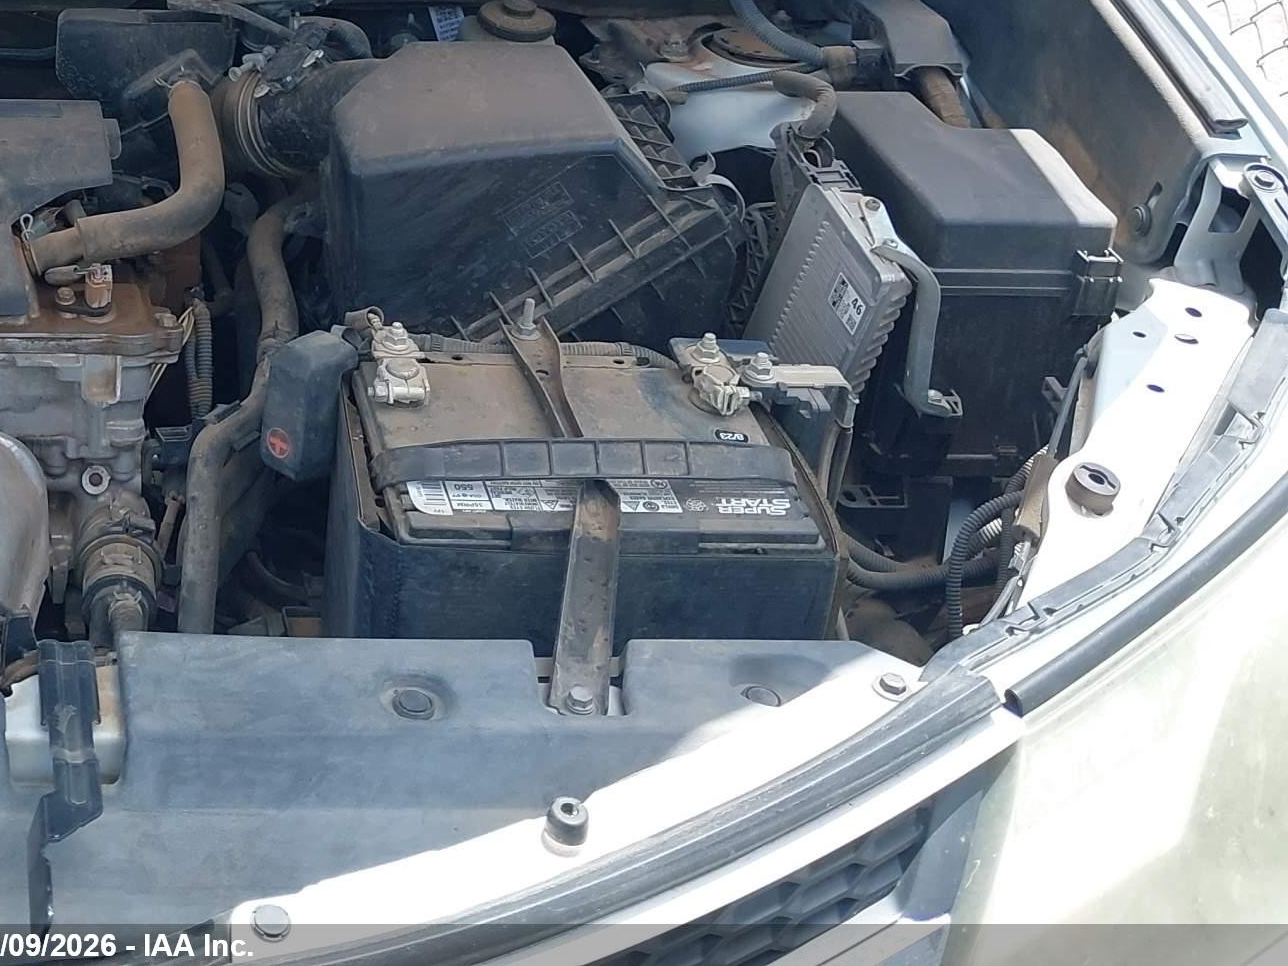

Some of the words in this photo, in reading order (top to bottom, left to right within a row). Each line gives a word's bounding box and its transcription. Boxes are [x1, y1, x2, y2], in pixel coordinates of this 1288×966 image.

[850, 297, 863, 316] 46
[454, 483, 474, 491] 550
[714, 498, 791, 507] START
[717, 506, 787, 516] SUPER
